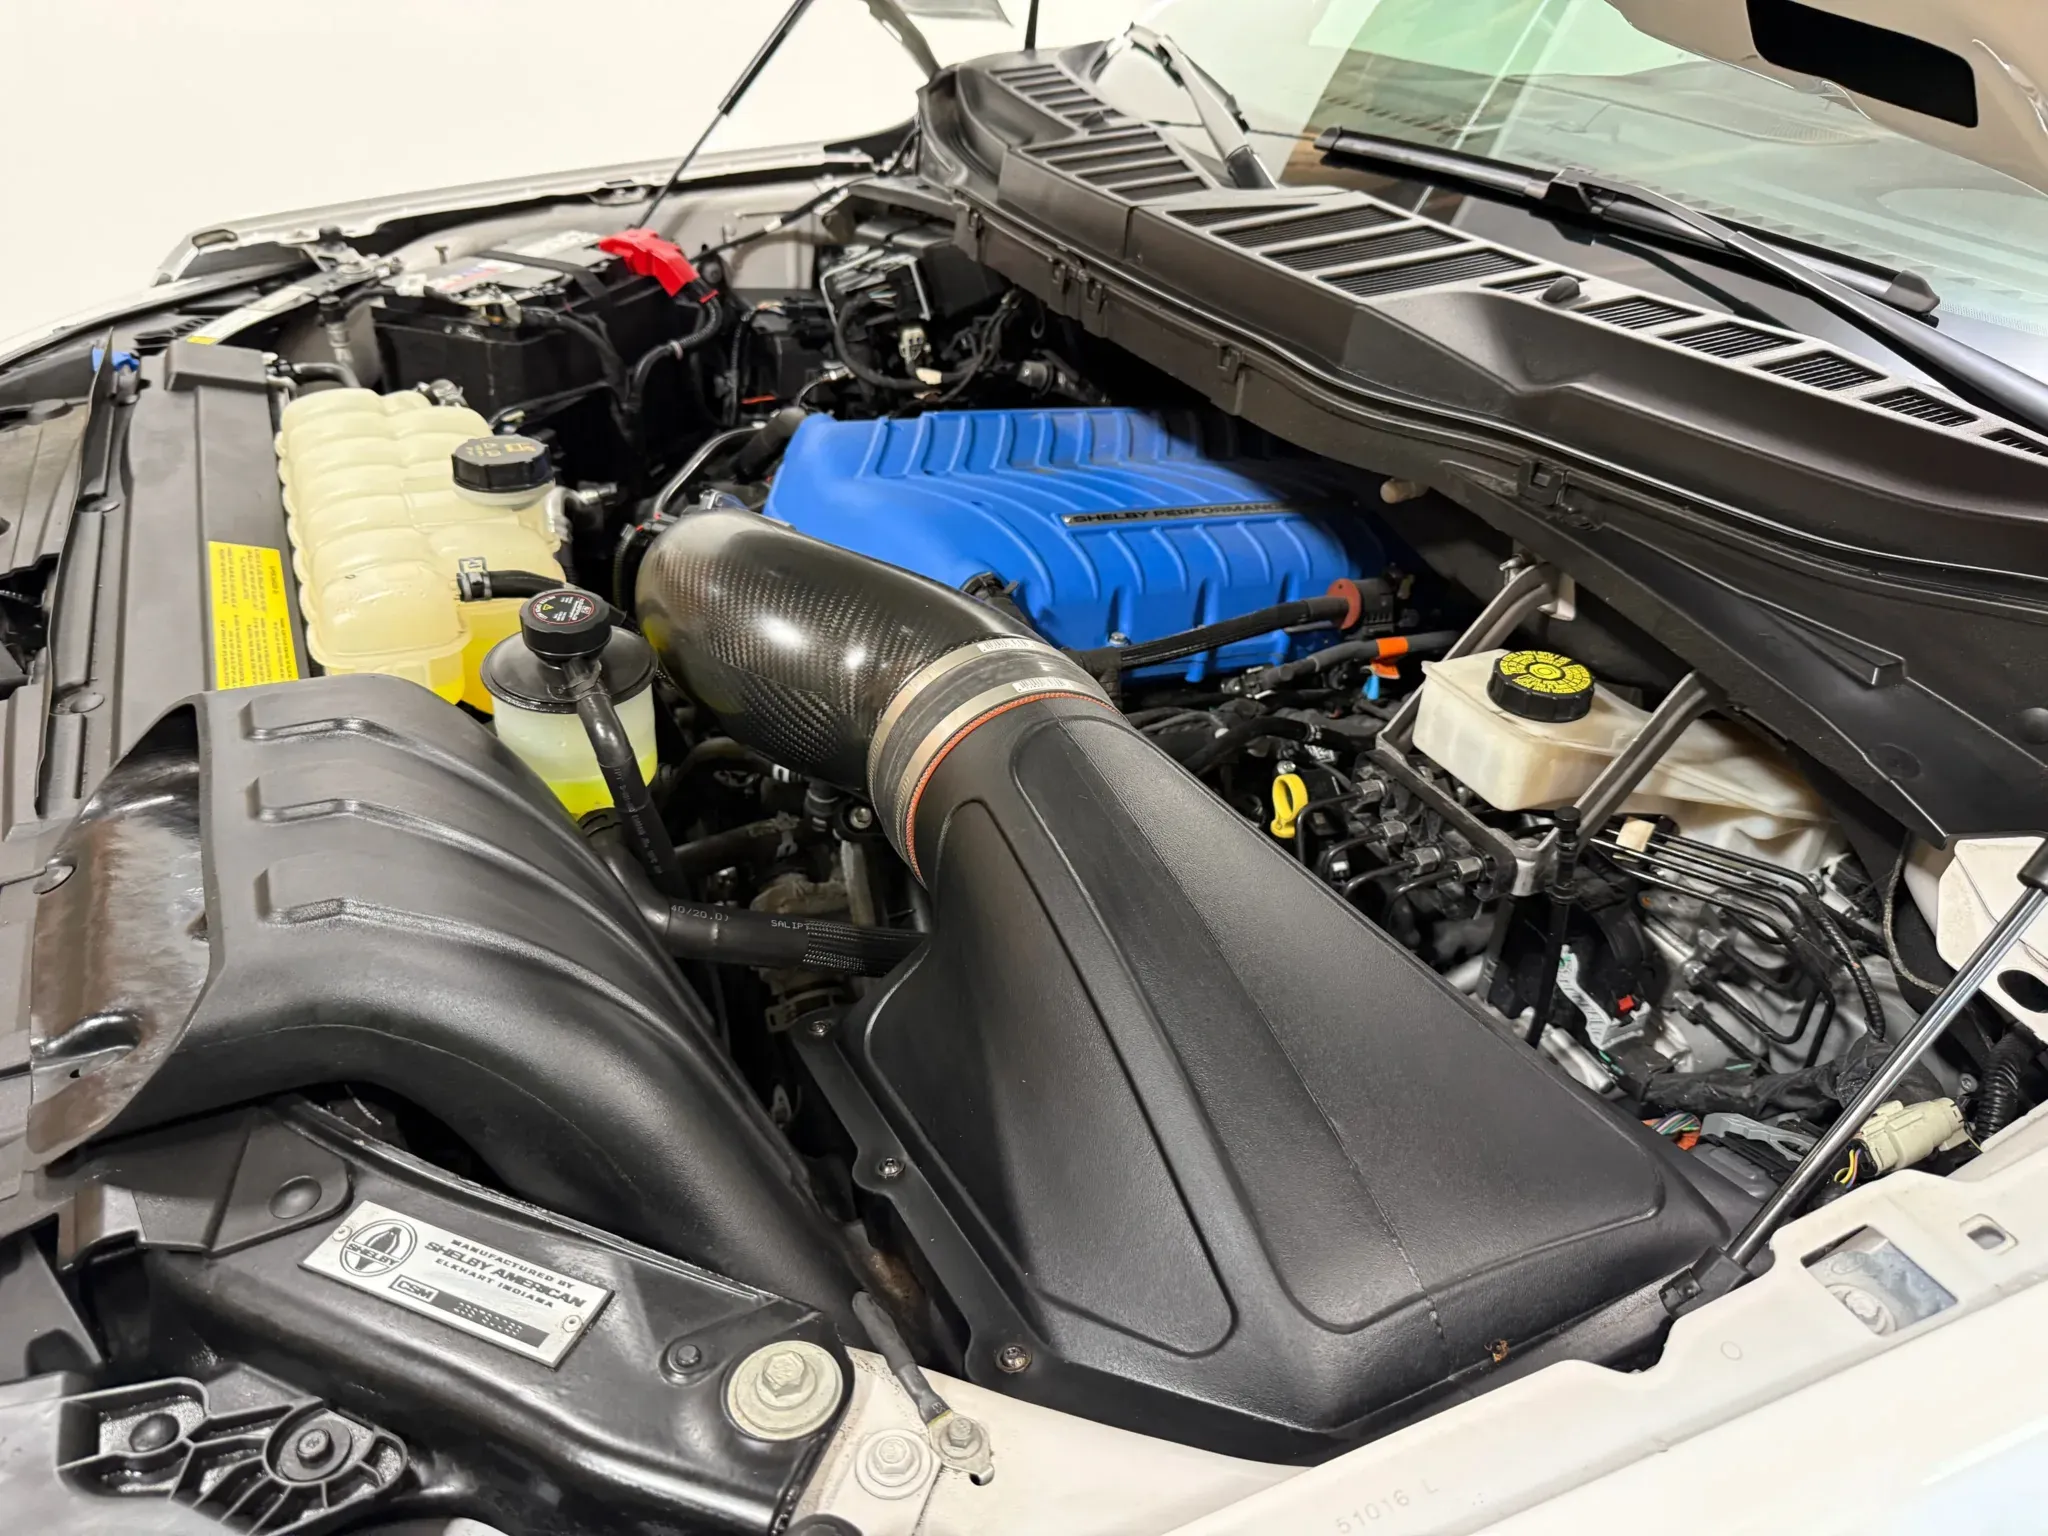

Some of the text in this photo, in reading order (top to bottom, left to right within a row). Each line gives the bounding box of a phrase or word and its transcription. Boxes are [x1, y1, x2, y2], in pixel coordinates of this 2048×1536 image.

[1073, 501, 1286, 523] SHELBY PERFORMANC
[346, 1242, 398, 1266] SHELBY
[425, 1241, 587, 1308] SHELBY AMERICAN
[451, 1238, 575, 1290] MANUFACTURED BY
[397, 1279, 435, 1301] CSM
[434, 1258, 554, 1308] ELKHART INDIANA
[1335, 1488, 1410, 1535] 51016
